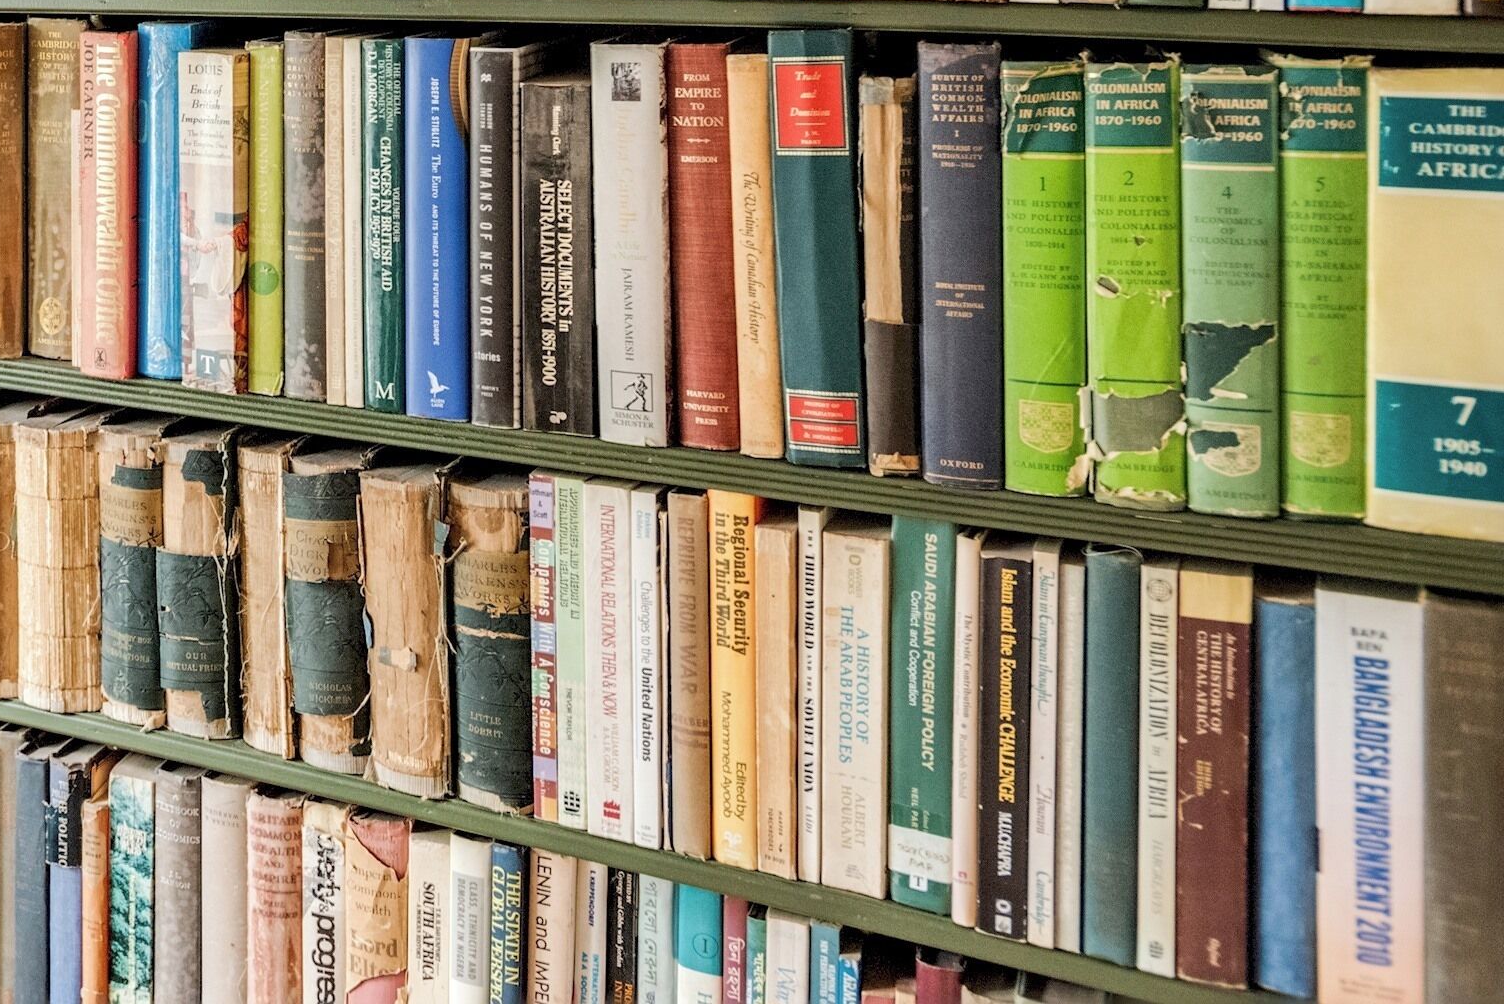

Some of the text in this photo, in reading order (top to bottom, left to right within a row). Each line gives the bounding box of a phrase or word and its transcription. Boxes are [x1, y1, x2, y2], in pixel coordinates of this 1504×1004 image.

[84, 40, 94, 159] JOE GARNER
[188, 64, 223, 76] LOUIS
[430, 77, 439, 105] JOSEPH
[675, 88, 722, 98] EMPIRE
[684, 74, 710, 82] FROM
[1089, 83, 1166, 94] COLONIALISM
[431, 115, 440, 148] STIGLITZ
[672, 116, 724, 127] NATION
[1096, 99, 1159, 110] IN AFRICA
[431, 155, 441, 173] The
[431, 176, 441, 199] Euro
[680, 156, 718, 164] EMERSON
[380, 136, 392, 292] CHANGES IN BRITISH AID
[480, 144, 493, 338] HUMANS OF NEW YORK
[557, 180, 574, 332] SELECT DOCUMENTS in
[474, 351, 500, 363] stories
[715, 512, 730, 648] in the Third World
[731, 515, 750, 656] Regional Security
[537, 539, 555, 755] Companies With A Conscience
[920, 533, 937, 771] SAUDI ARABIAN FOREIGN POLICY
[641, 667, 654, 762] United Nations
[999, 568, 1017, 802] Islam and the Economic CHALLENGE
[1353, 656, 1393, 967] BANGLADESH ENVIRONMENT 2010
[422, 882, 435, 981] SOUTH AFRICA
